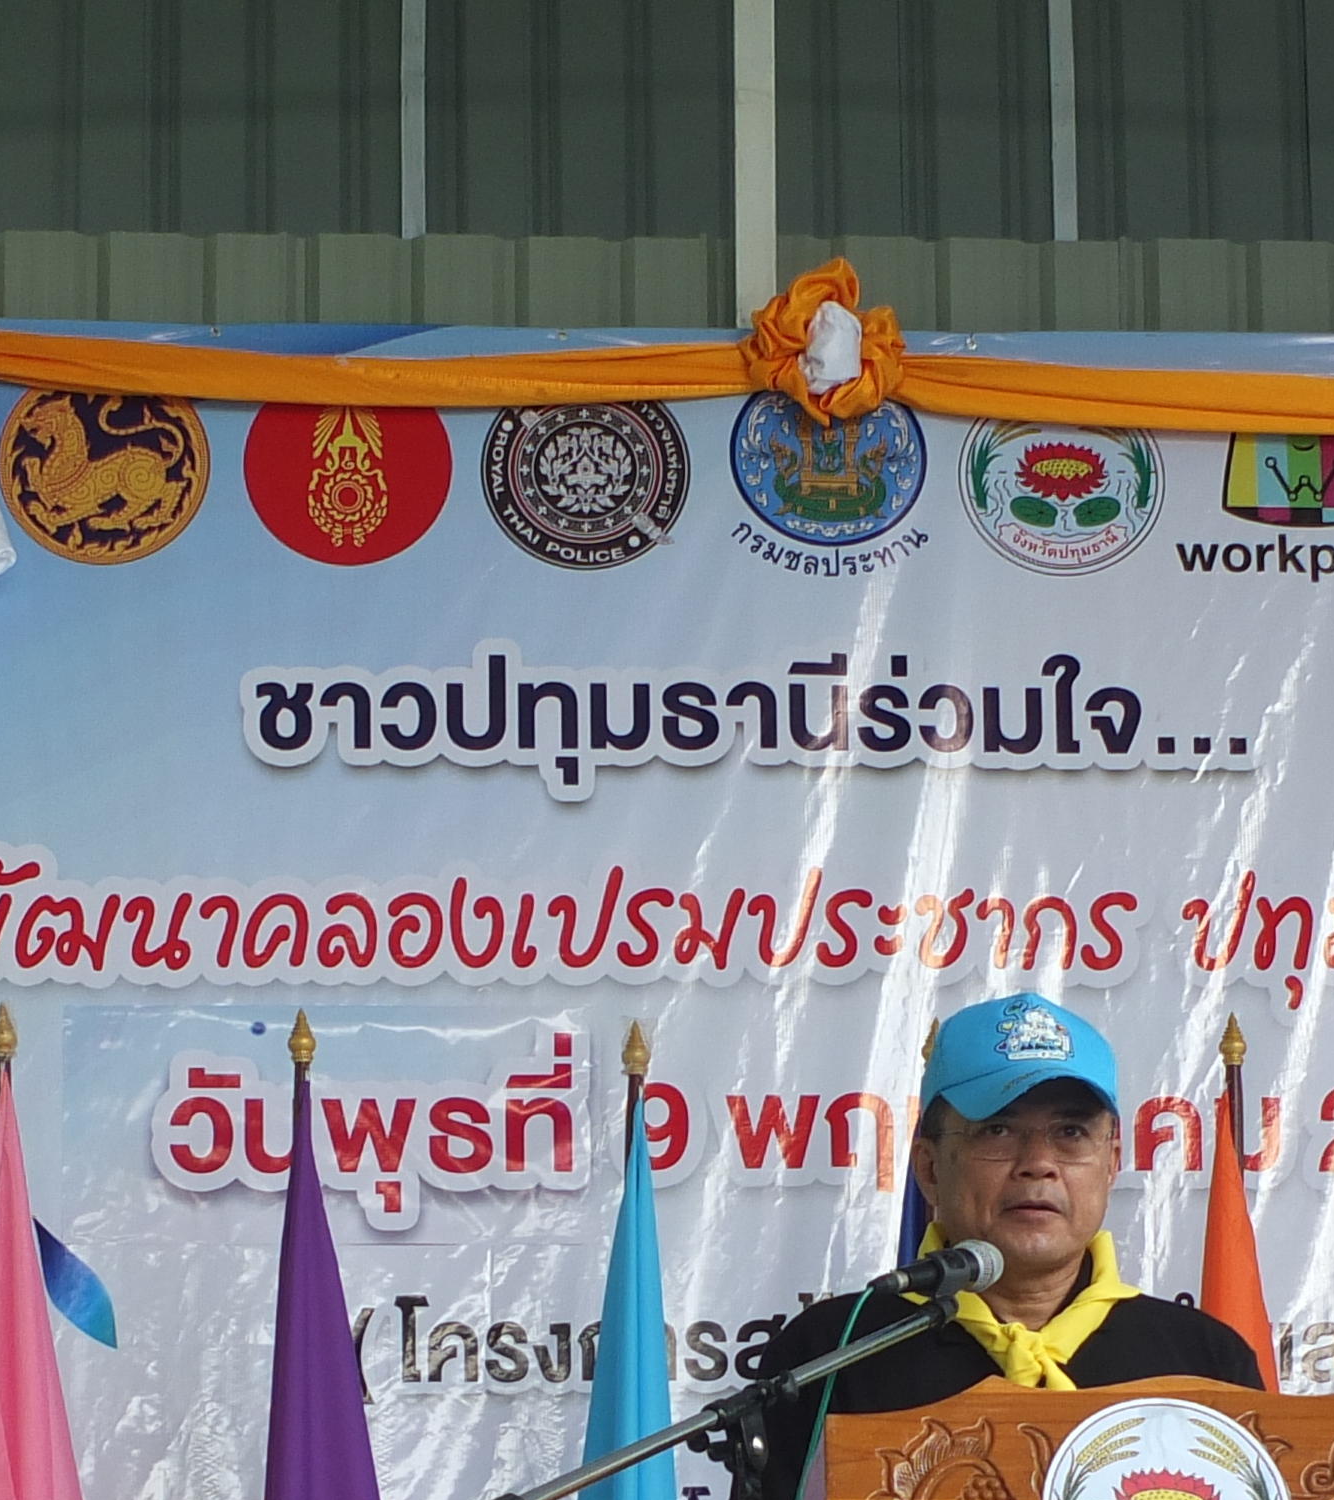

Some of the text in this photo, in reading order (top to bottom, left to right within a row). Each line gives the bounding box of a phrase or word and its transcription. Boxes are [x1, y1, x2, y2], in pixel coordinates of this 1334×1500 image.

[491, 433, 626, 563] ROYAL THAI POLICE
[731, 522, 929, 577] กรมชลประทาน
[255, 652, 1247, 785] ชาวปทุมธานีร่วมใจ...
